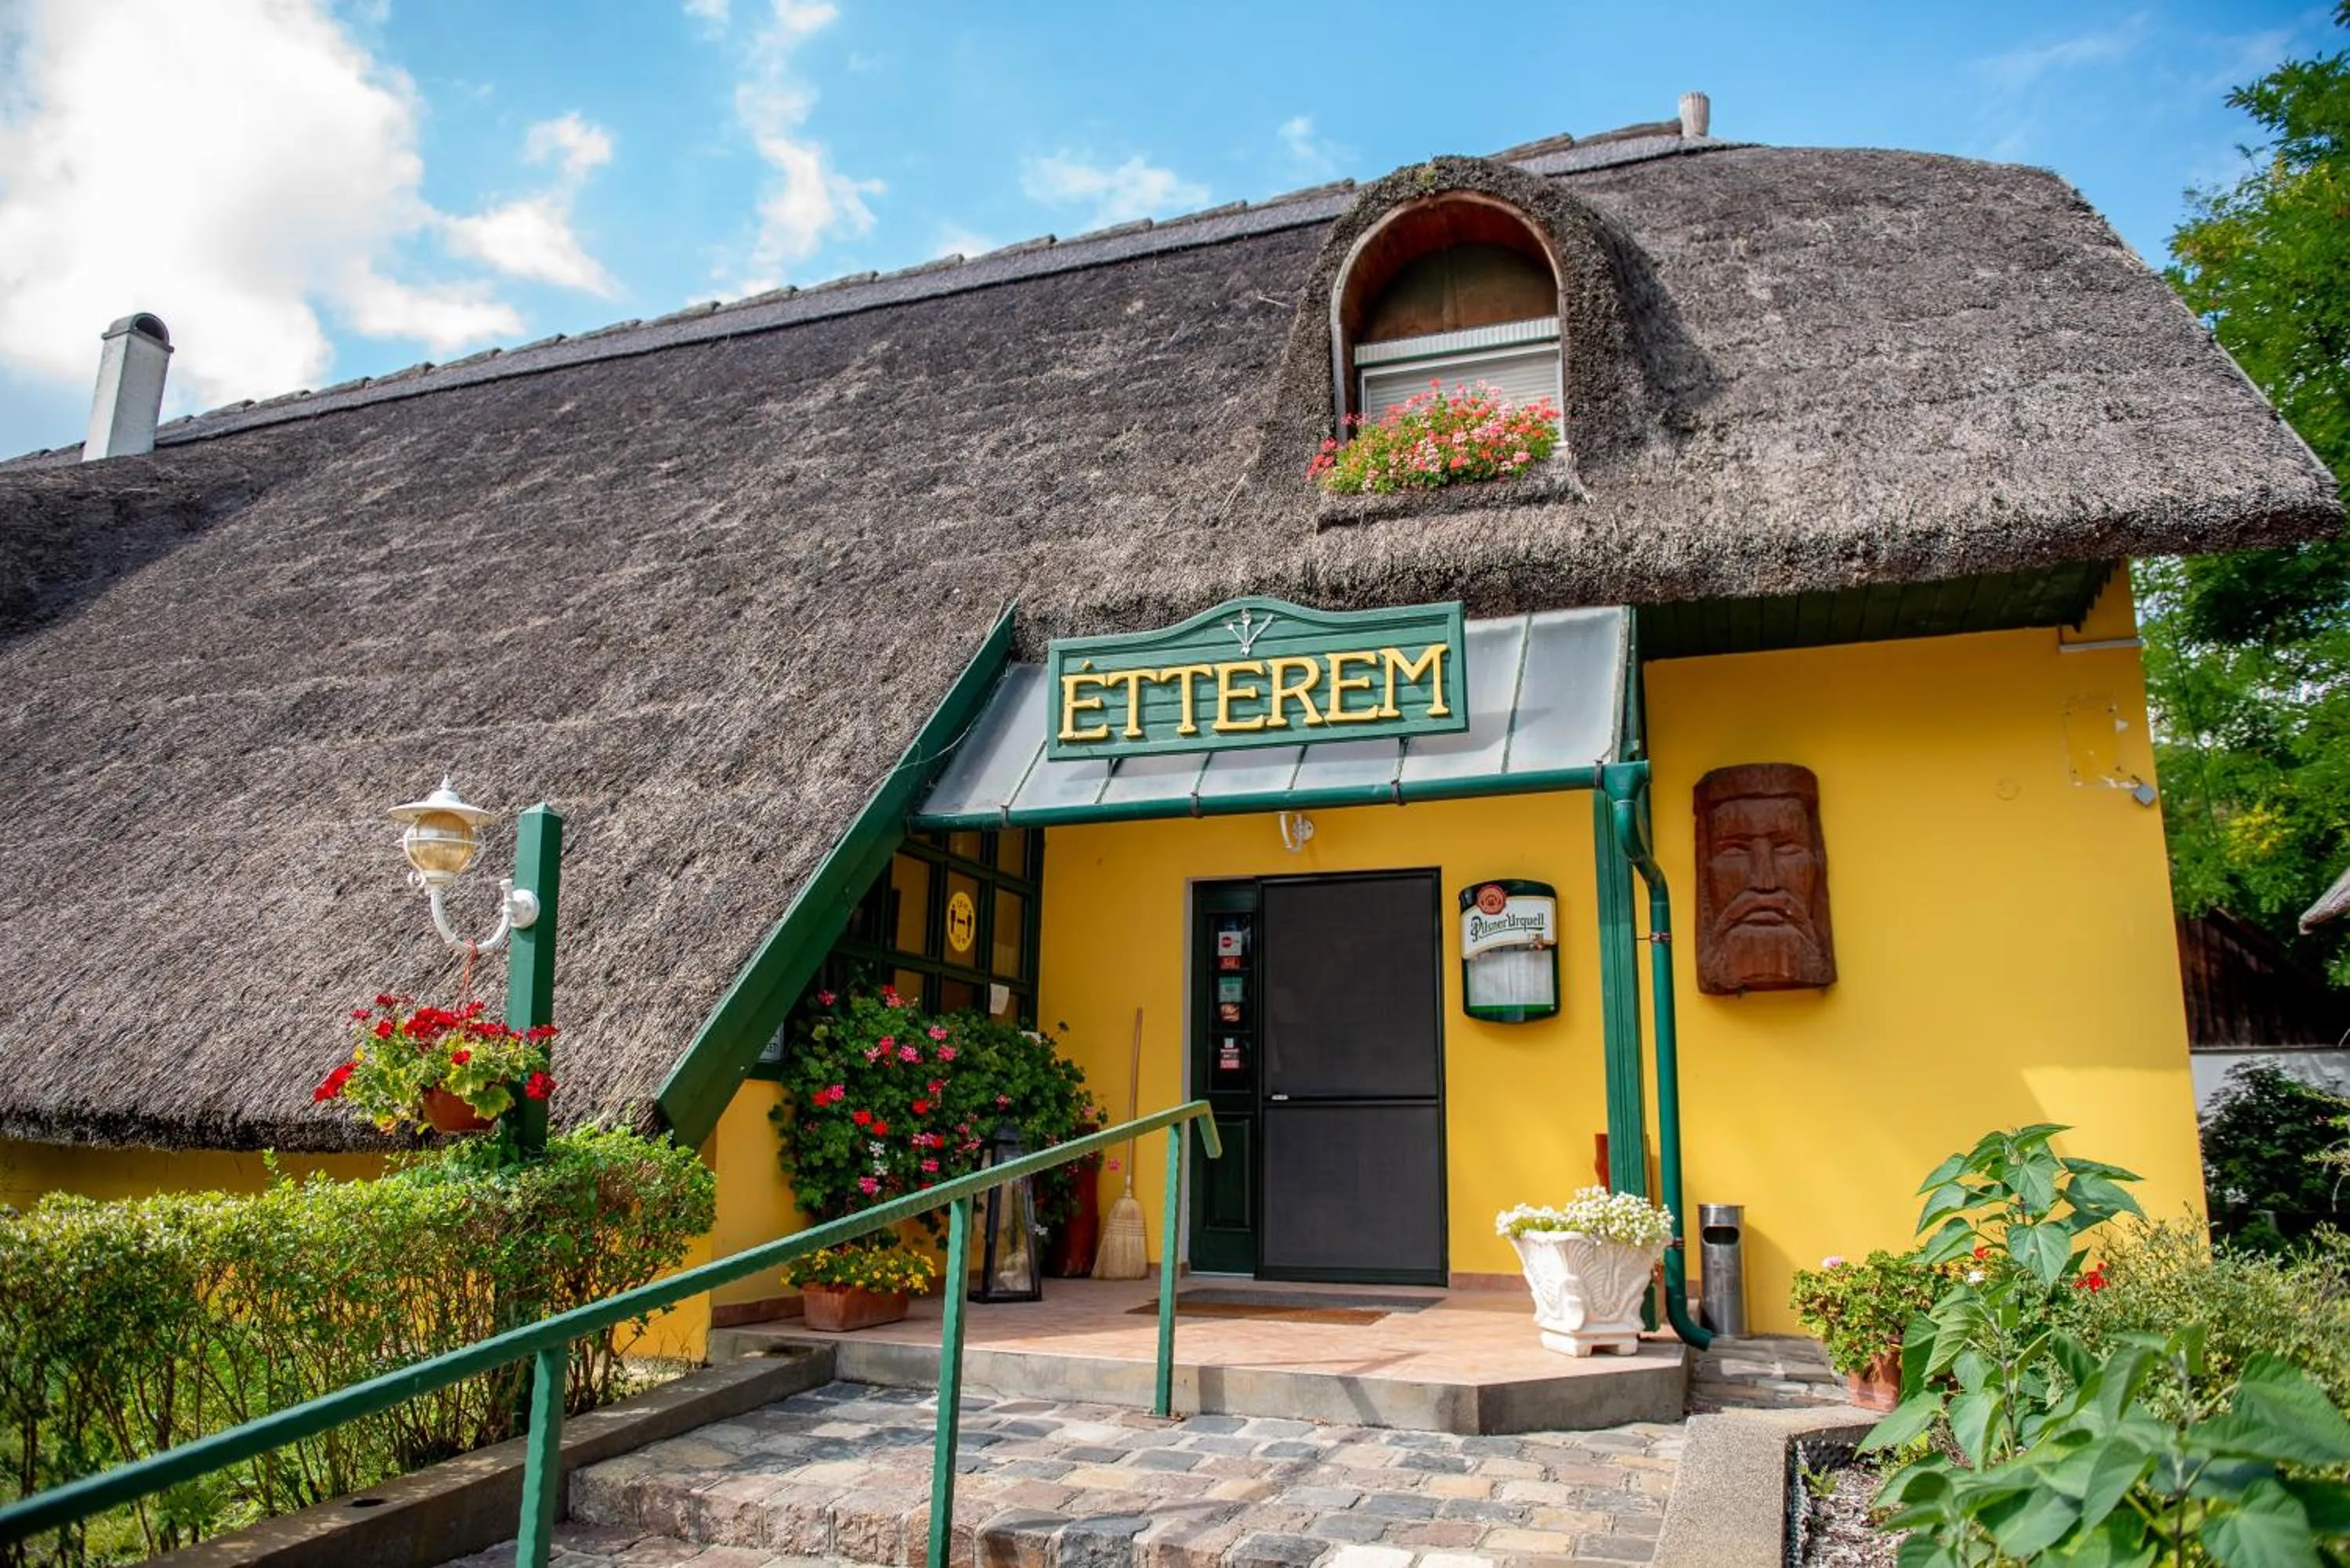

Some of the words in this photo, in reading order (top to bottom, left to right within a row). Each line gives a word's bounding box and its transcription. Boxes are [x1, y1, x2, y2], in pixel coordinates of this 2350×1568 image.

[1058, 643, 1449, 742] ÉTTEREM
[1470, 916, 1507, 942] Pilsner
[1506, 912, 1544, 932] Urquell
